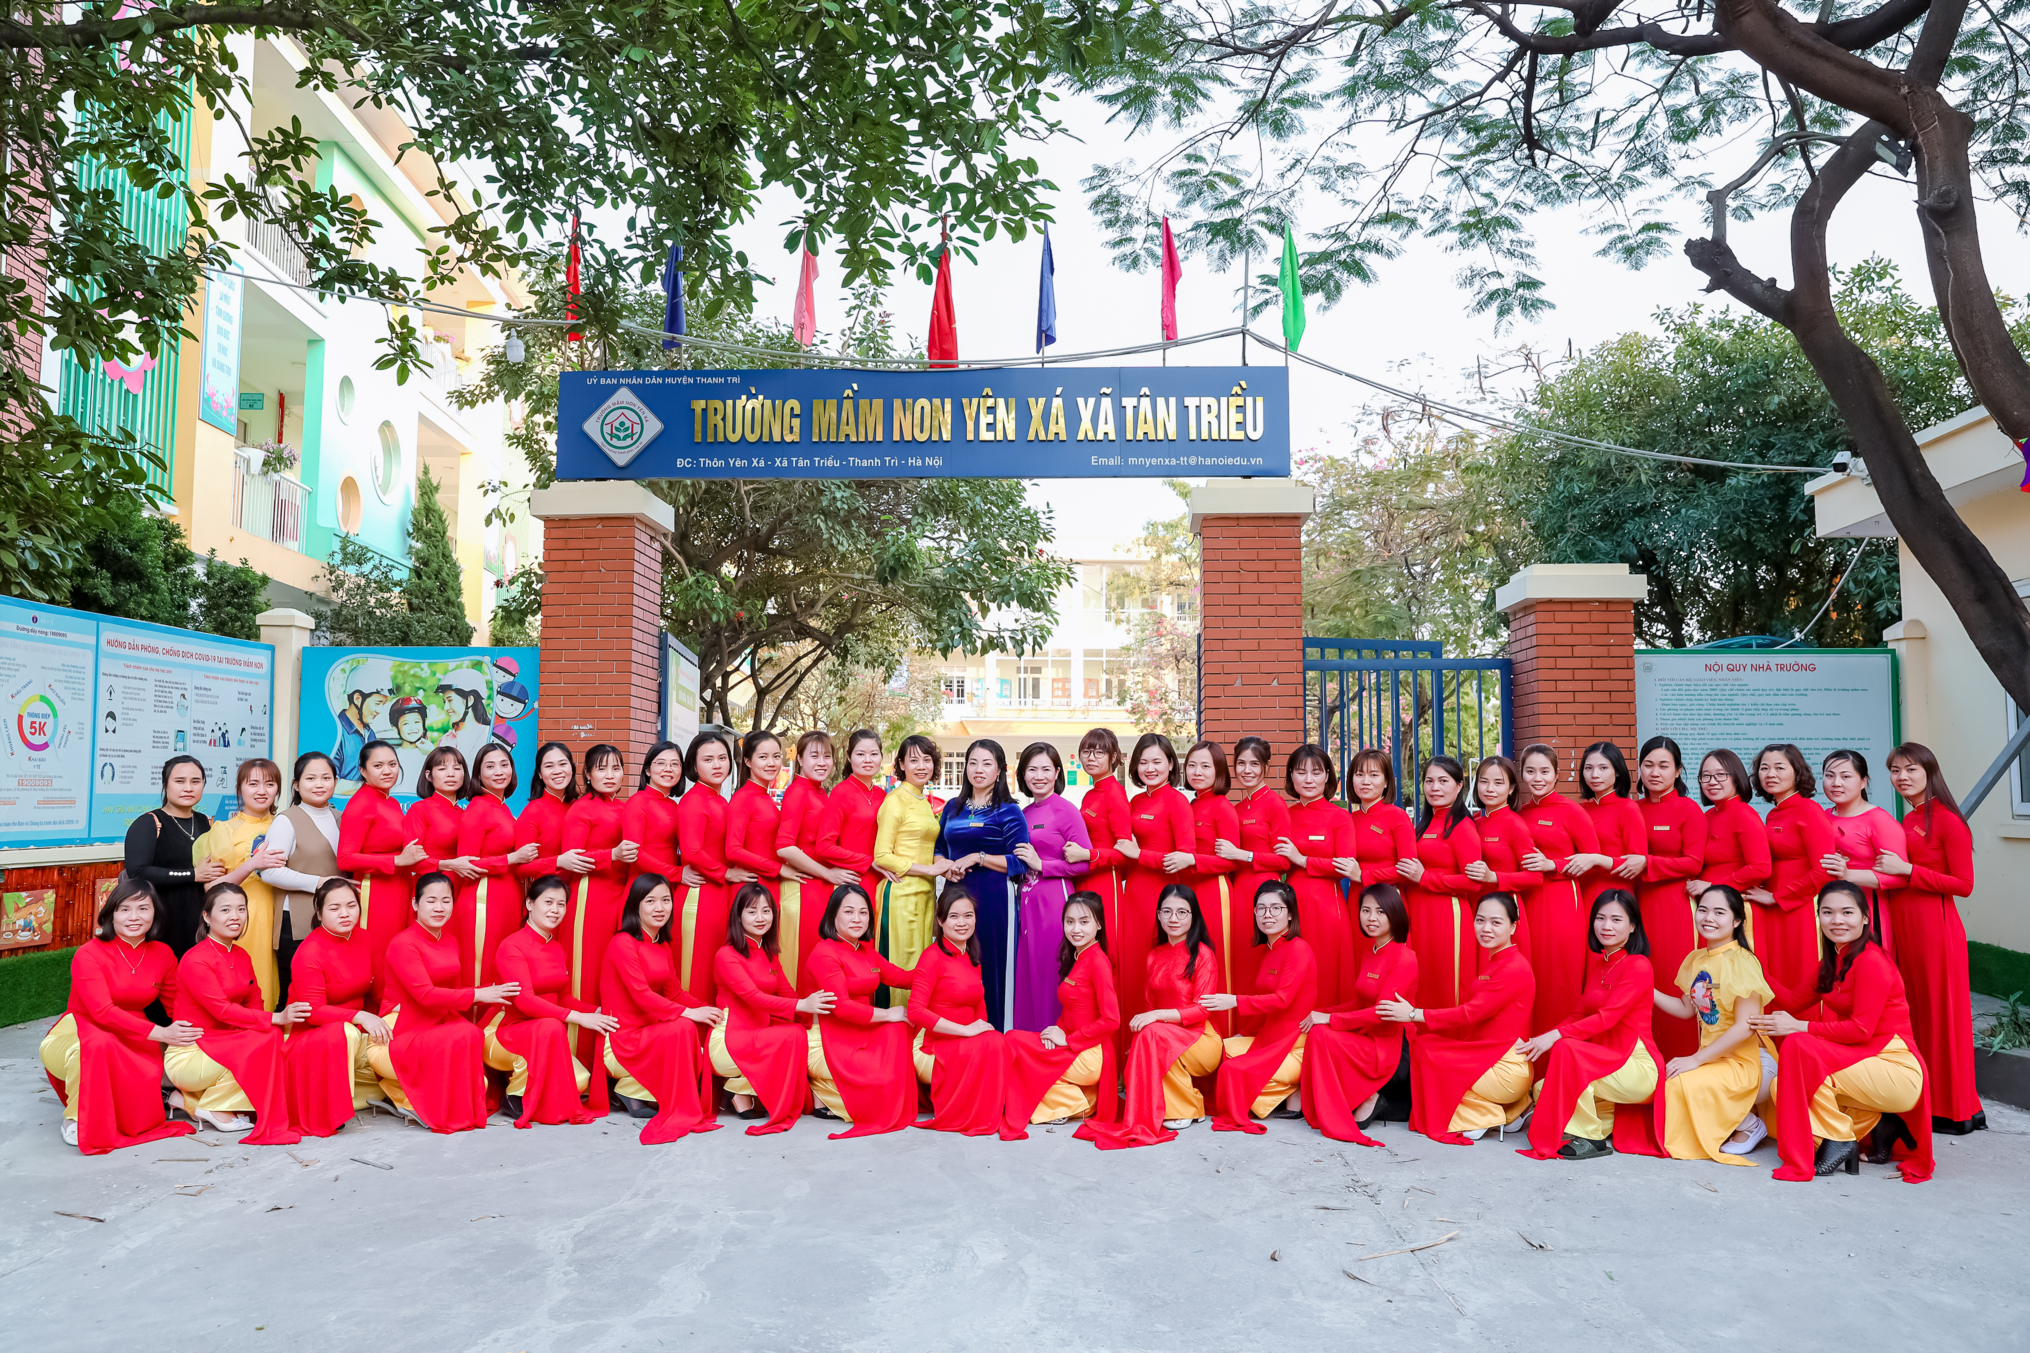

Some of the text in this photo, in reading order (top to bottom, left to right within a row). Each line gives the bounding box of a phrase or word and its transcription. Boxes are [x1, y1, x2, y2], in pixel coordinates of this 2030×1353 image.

[586, 375, 741, 386] UỶ BAN NHÂN DÂN HUYỆN THANH TRÌ
[691, 380, 1265, 443] TRƯỜNG MẦM NON YÊN XÁ XÃ TÂN TRIỀU
[676, 457, 697, 468] ĐC:
[698, 457, 725, 468] Thôn
[728, 457, 748, 468] Yên
[751, 456, 766, 467] Xá
[774, 456, 788, 467] Xã
[790, 456, 811, 467] Tân
[813, 455, 840, 467] Triều
[849, 456, 881, 467] Thanh
[884, 456, 898, 467] Trì
[908, 456, 922, 467] Hà
[925, 456, 943, 469] Nội
[1091, 455, 1263, 468] Email: mnyenxa-tt@hanoiedu.vn
[16, 625, 30, 634] Đường
[106, 637, 127, 650] HƯỚNG
[128, 639, 140, 652] DẪN
[140, 643, 160, 656] PHÒNG,
[161, 645, 181, 658] CHỐNG
[181, 650, 194, 661] DỊCH
[194, 652, 216, 663] COVID-19
[216, 655, 224, 666] TẠI
[224, 656, 243, 667] TRƯỜNG
[1704, 660, 1817, 674] NỘI QUY NHÀ TRƯỜNG
[29, 720, 47, 736] 5K
